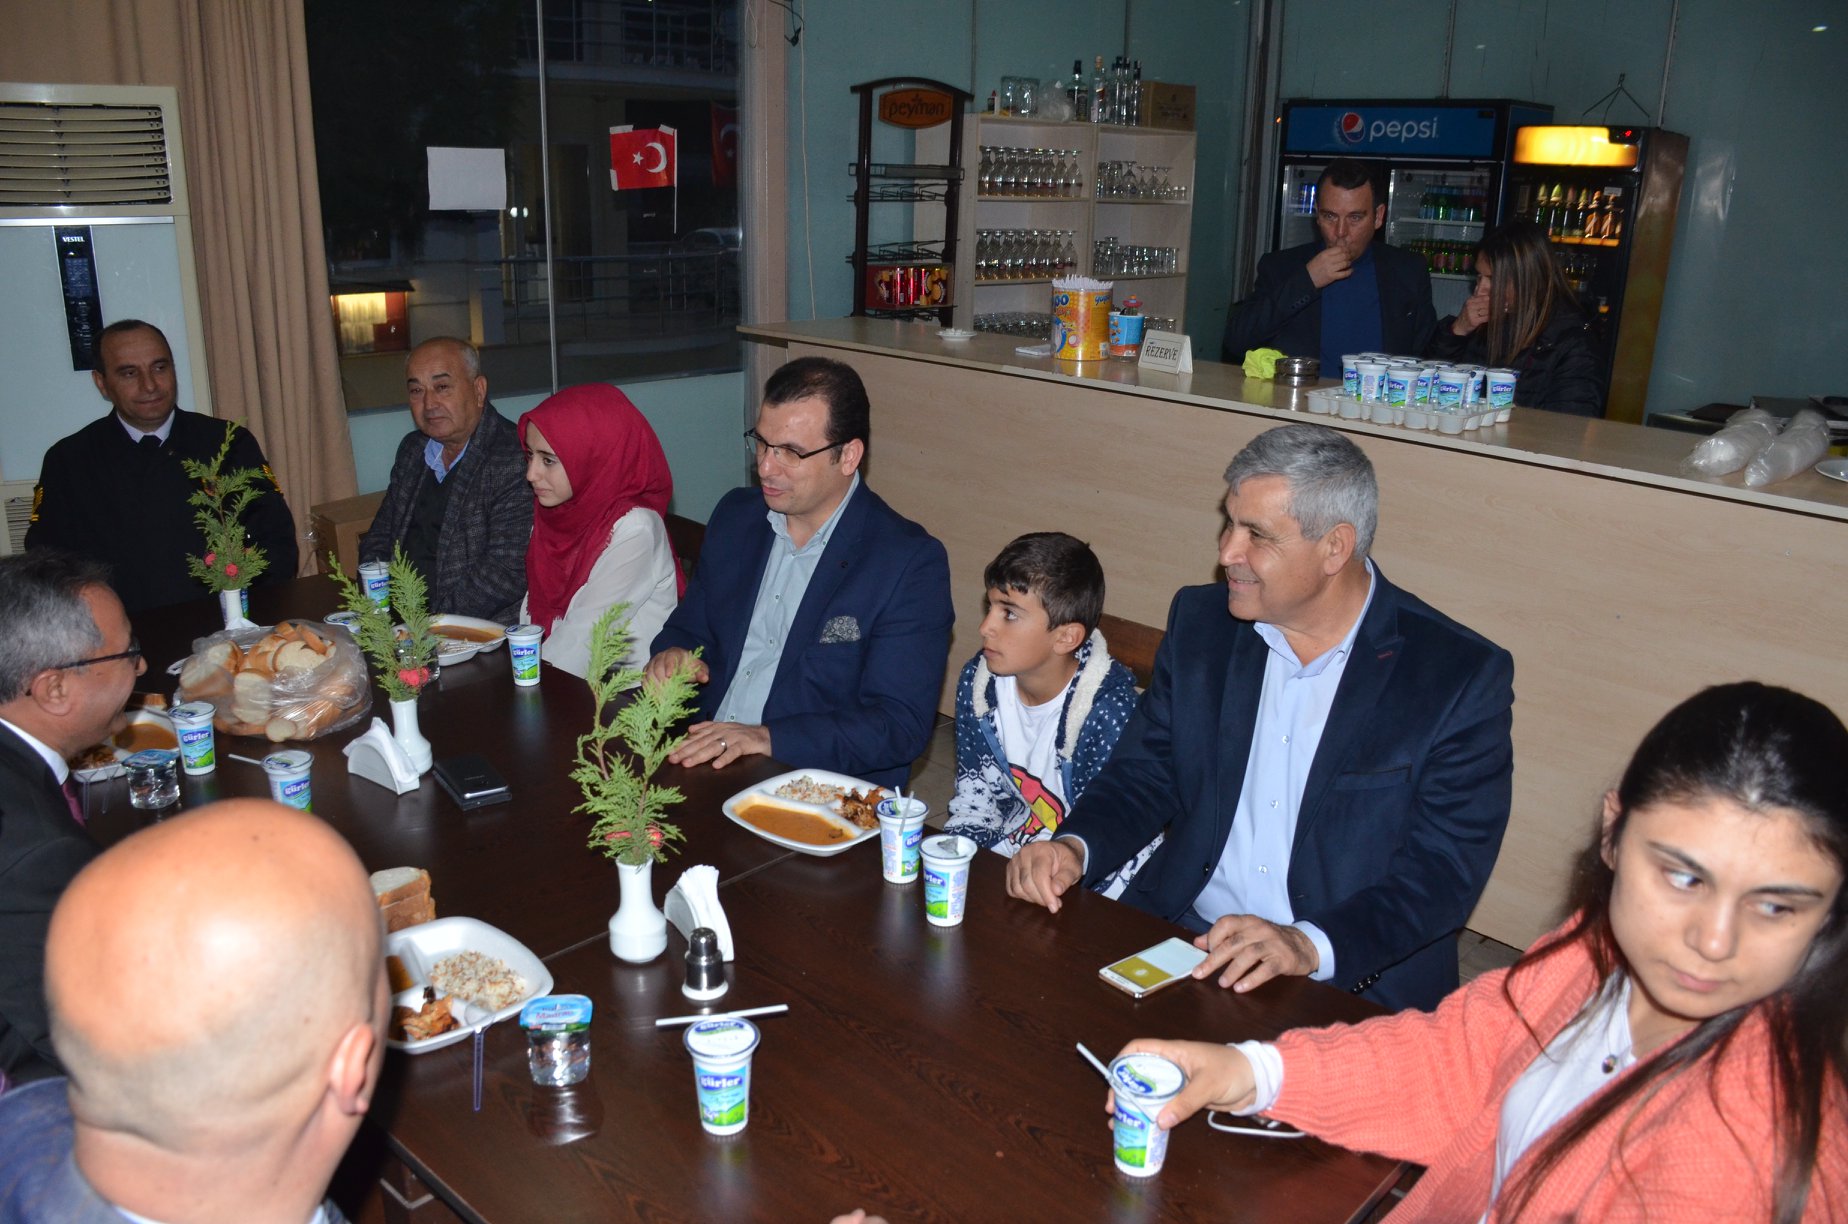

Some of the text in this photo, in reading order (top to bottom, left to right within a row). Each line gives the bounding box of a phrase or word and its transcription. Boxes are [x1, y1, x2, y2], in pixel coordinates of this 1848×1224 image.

[888, 101, 945, 118] peyman
[1369, 116, 1438, 143] pepsi
[1145, 345, 1179, 361] REZERVE
[182, 732, 210, 743] gürler
